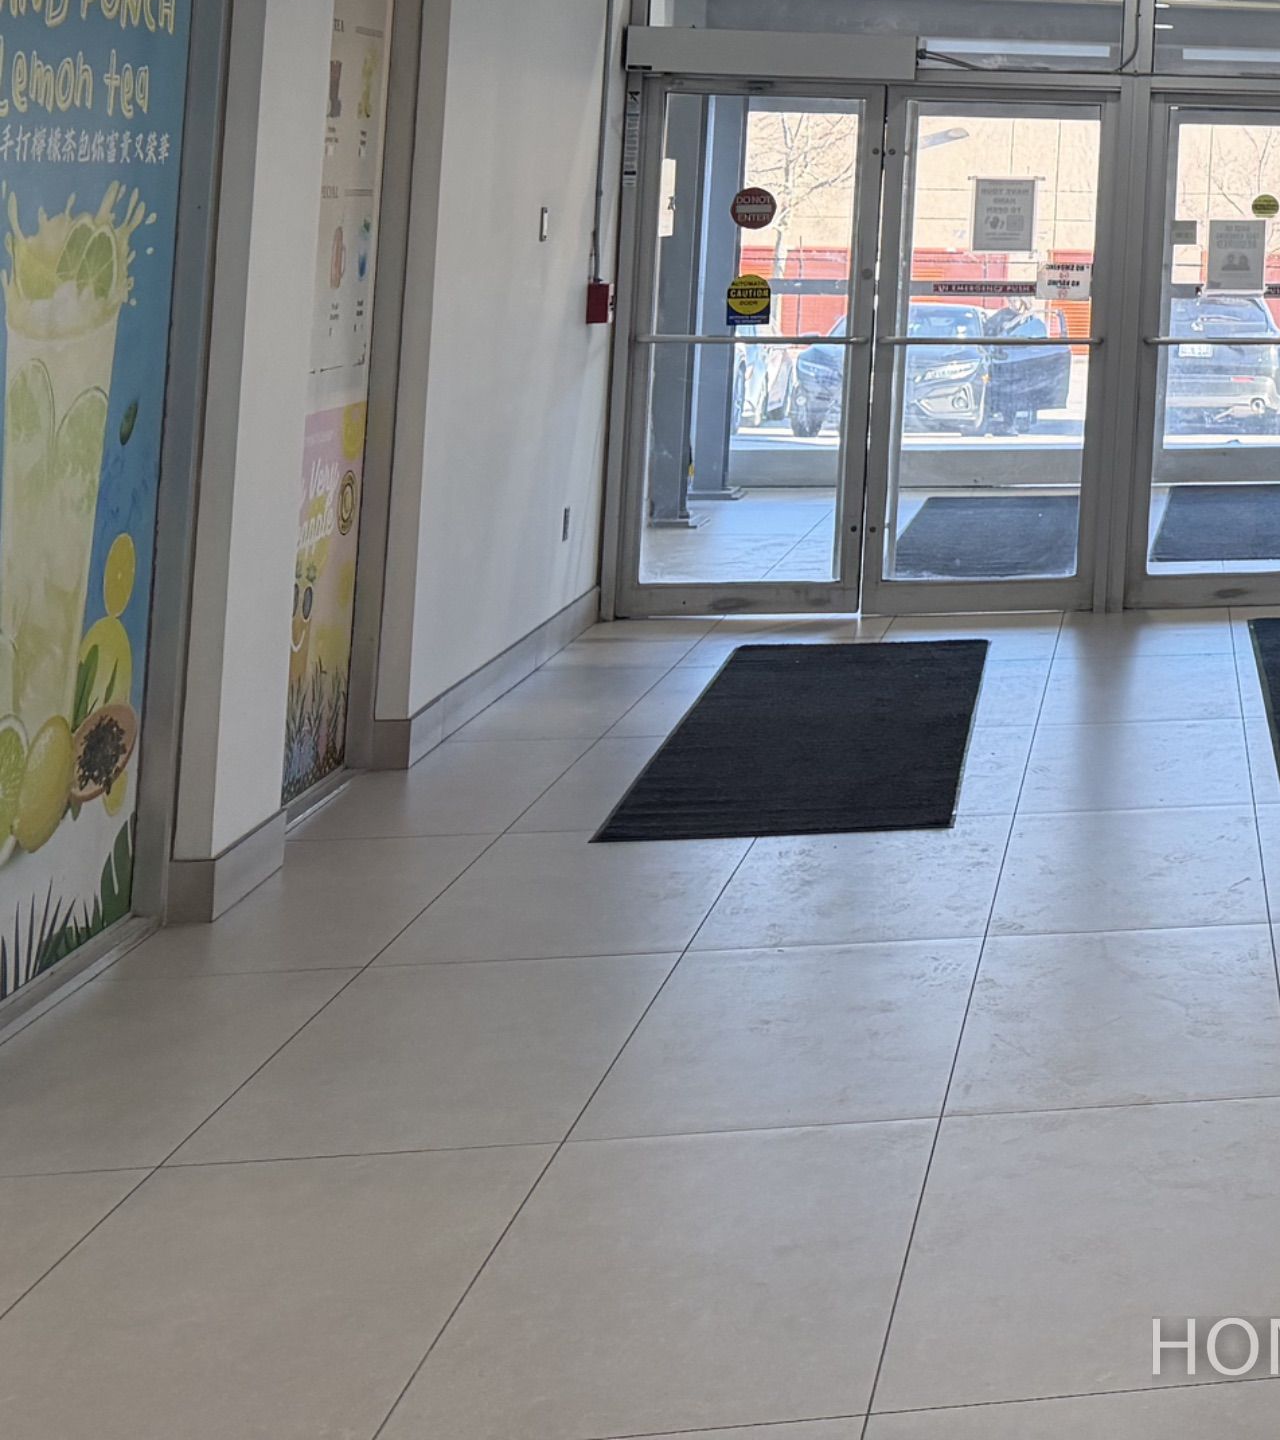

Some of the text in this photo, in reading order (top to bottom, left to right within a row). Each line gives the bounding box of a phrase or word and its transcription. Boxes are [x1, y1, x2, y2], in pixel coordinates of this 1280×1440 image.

[103, 49, 150, 120] tea
[753, 195, 771, 204] NOT
[737, 213, 770, 223] ENTER
[729, 288, 769, 299] CAUTION
[952, 285, 1004, 293] EMERGENCY
[1006, 285, 1031, 293] PUSH
